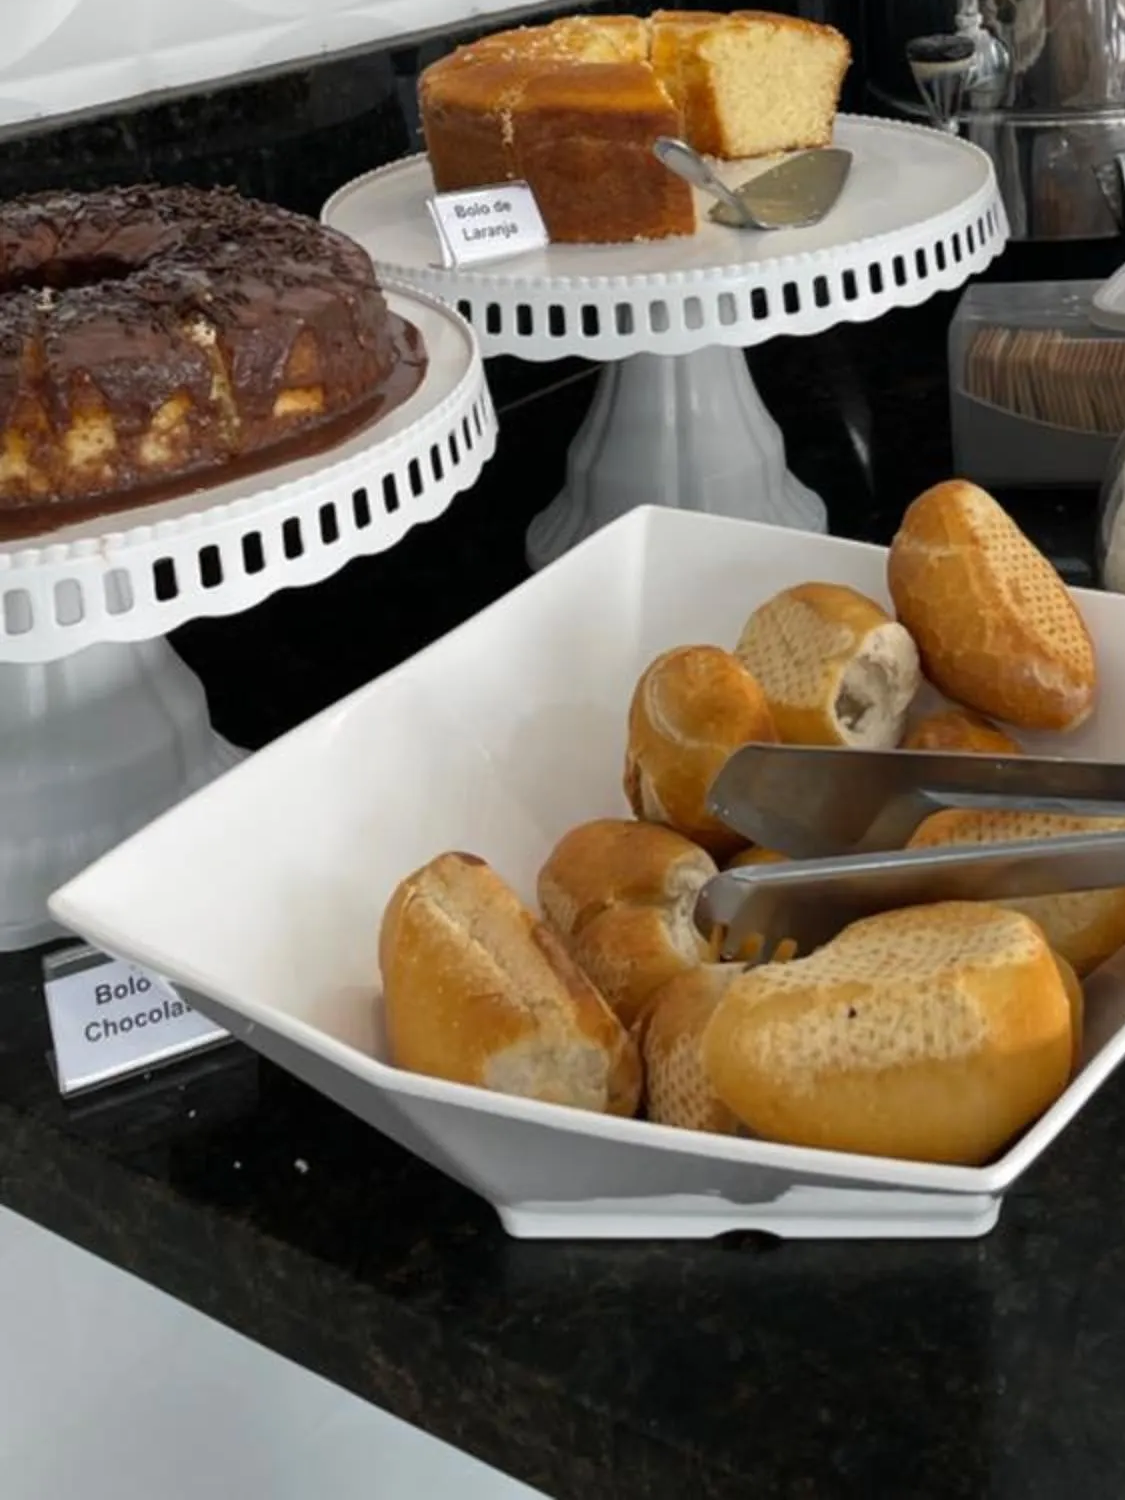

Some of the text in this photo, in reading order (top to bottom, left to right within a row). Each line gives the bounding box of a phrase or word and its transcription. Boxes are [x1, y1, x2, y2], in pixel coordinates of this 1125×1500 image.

[454, 200, 511, 218] Bolo de
[462, 223, 518, 241] Laranja
[95, 975, 151, 1005] Bolo
